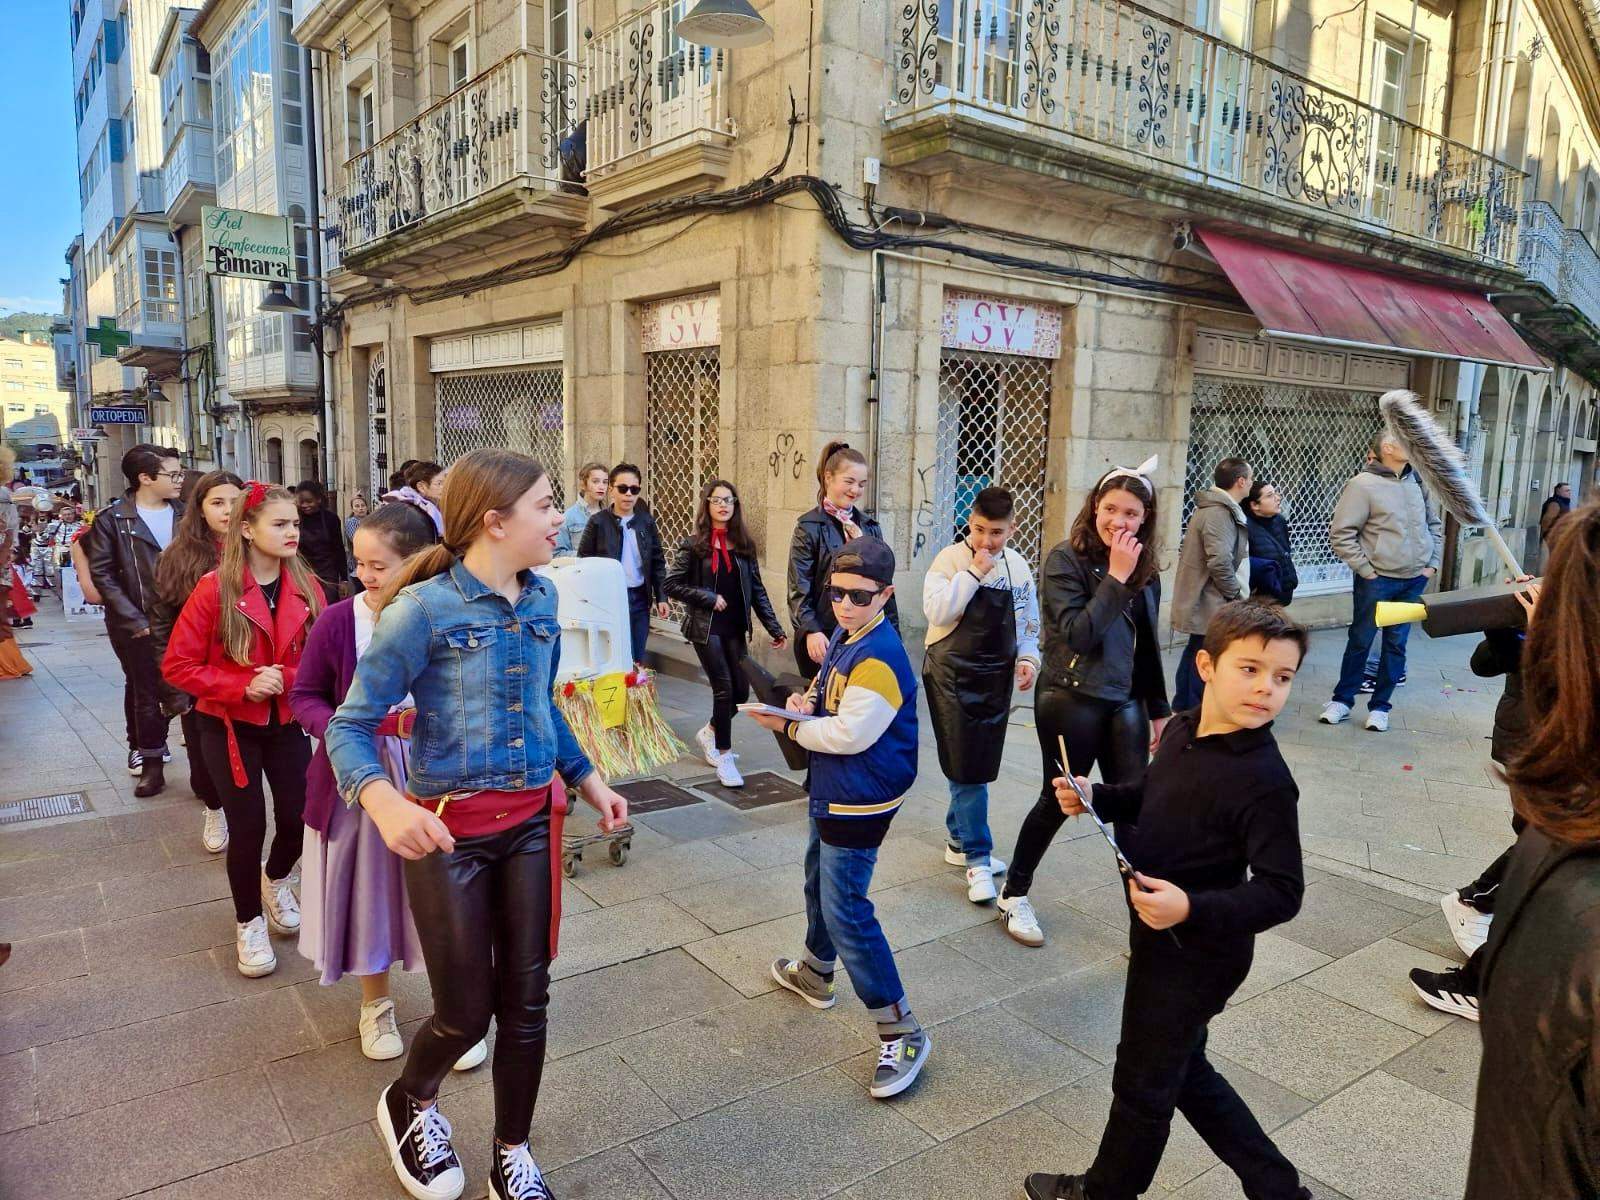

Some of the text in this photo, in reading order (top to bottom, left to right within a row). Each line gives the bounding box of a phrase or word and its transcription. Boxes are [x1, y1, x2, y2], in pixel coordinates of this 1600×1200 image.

[206, 210, 243, 230] Piel
[212, 229, 291, 257] Confecciones
[208, 245, 289, 278] Tamara
[971, 302, 1025, 348] SV
[91, 410, 145, 422] ORTOPEDIA
[601, 686, 618, 710] 7
